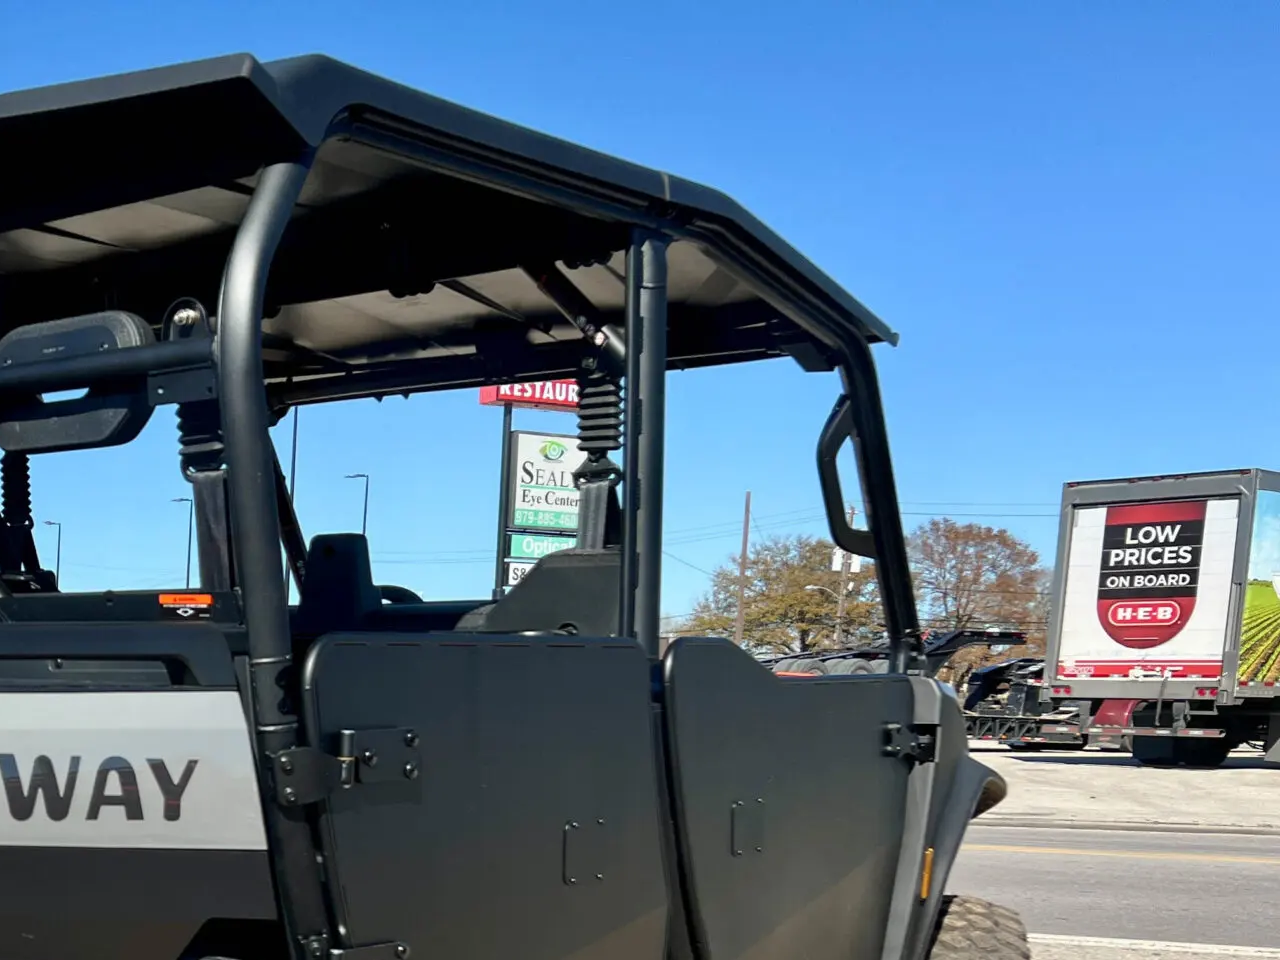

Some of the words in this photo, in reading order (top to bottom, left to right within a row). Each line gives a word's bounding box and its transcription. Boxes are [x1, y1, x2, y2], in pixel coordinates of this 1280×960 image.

[521, 460, 571, 488] SEAL
[521, 489, 542, 506] Eye
[545, 490, 578, 507] Center
[1125, 524, 1181, 545] LOW
[1109, 545, 1193, 567] PRICES
[1106, 575, 1131, 588] ON
[1133, 573, 1191, 587] BOARD
[1116, 606, 1174, 621] H-E-B
